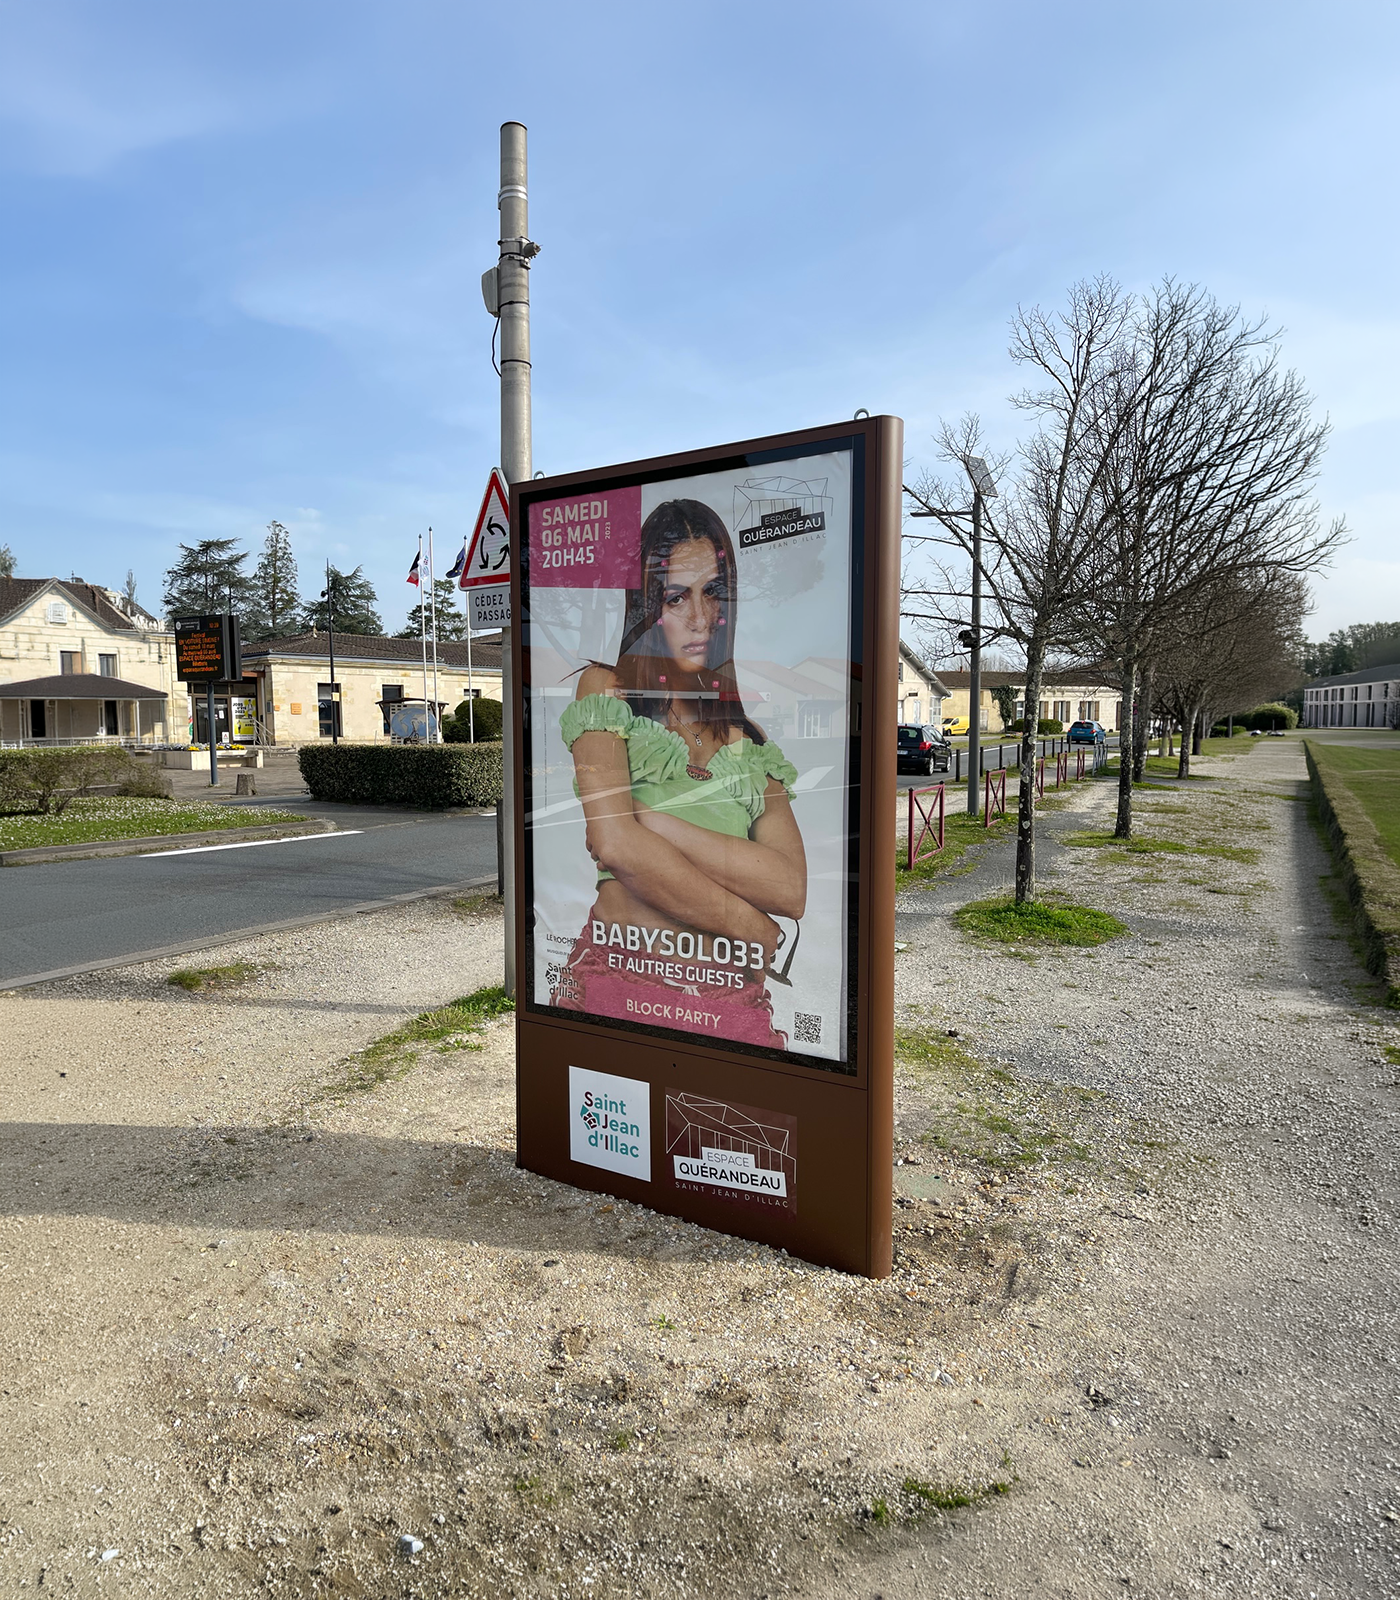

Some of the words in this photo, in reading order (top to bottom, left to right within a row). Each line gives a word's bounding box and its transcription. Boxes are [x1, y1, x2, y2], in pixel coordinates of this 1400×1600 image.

[542, 500, 608, 526] SAMEDI
[765, 511, 798, 526] ESPACE
[542, 528, 562, 548] 06
[568, 523, 600, 545] MAI
[743, 517, 821, 544] QUÉRANDEAU
[542, 546, 595, 568] 20H45
[740, 546, 762, 556] SAINT
[768, 541, 788, 550] JEAN
[474, 594, 504, 608] CÉDEZ
[478, 608, 512, 622] PASSAG
[592, 920, 764, 970] BABYSOLO33
[548, 962, 572, 975] Saint
[608, 953, 624, 970] ET
[626, 958, 683, 980] AUTRES
[686, 966, 744, 989] GUESTS
[550, 985, 578, 1000] d'Illac
[558, 974, 579, 988] Jean
[626, 998, 672, 1019] BLOCK
[675, 1007, 722, 1029] PARTY
[584, 1091, 626, 1116] Saint
[602, 1114, 640, 1138] Jean
[588, 1130, 639, 1158] d'Illac
[708, 1152, 750, 1168] ESPACE
[679, 1162, 781, 1190] QUÉRANDEAU
[676, 1181, 706, 1192] SAINT
[712, 1188, 738, 1198] JEAN
[744, 1194, 788, 1208] D'ILLAC
